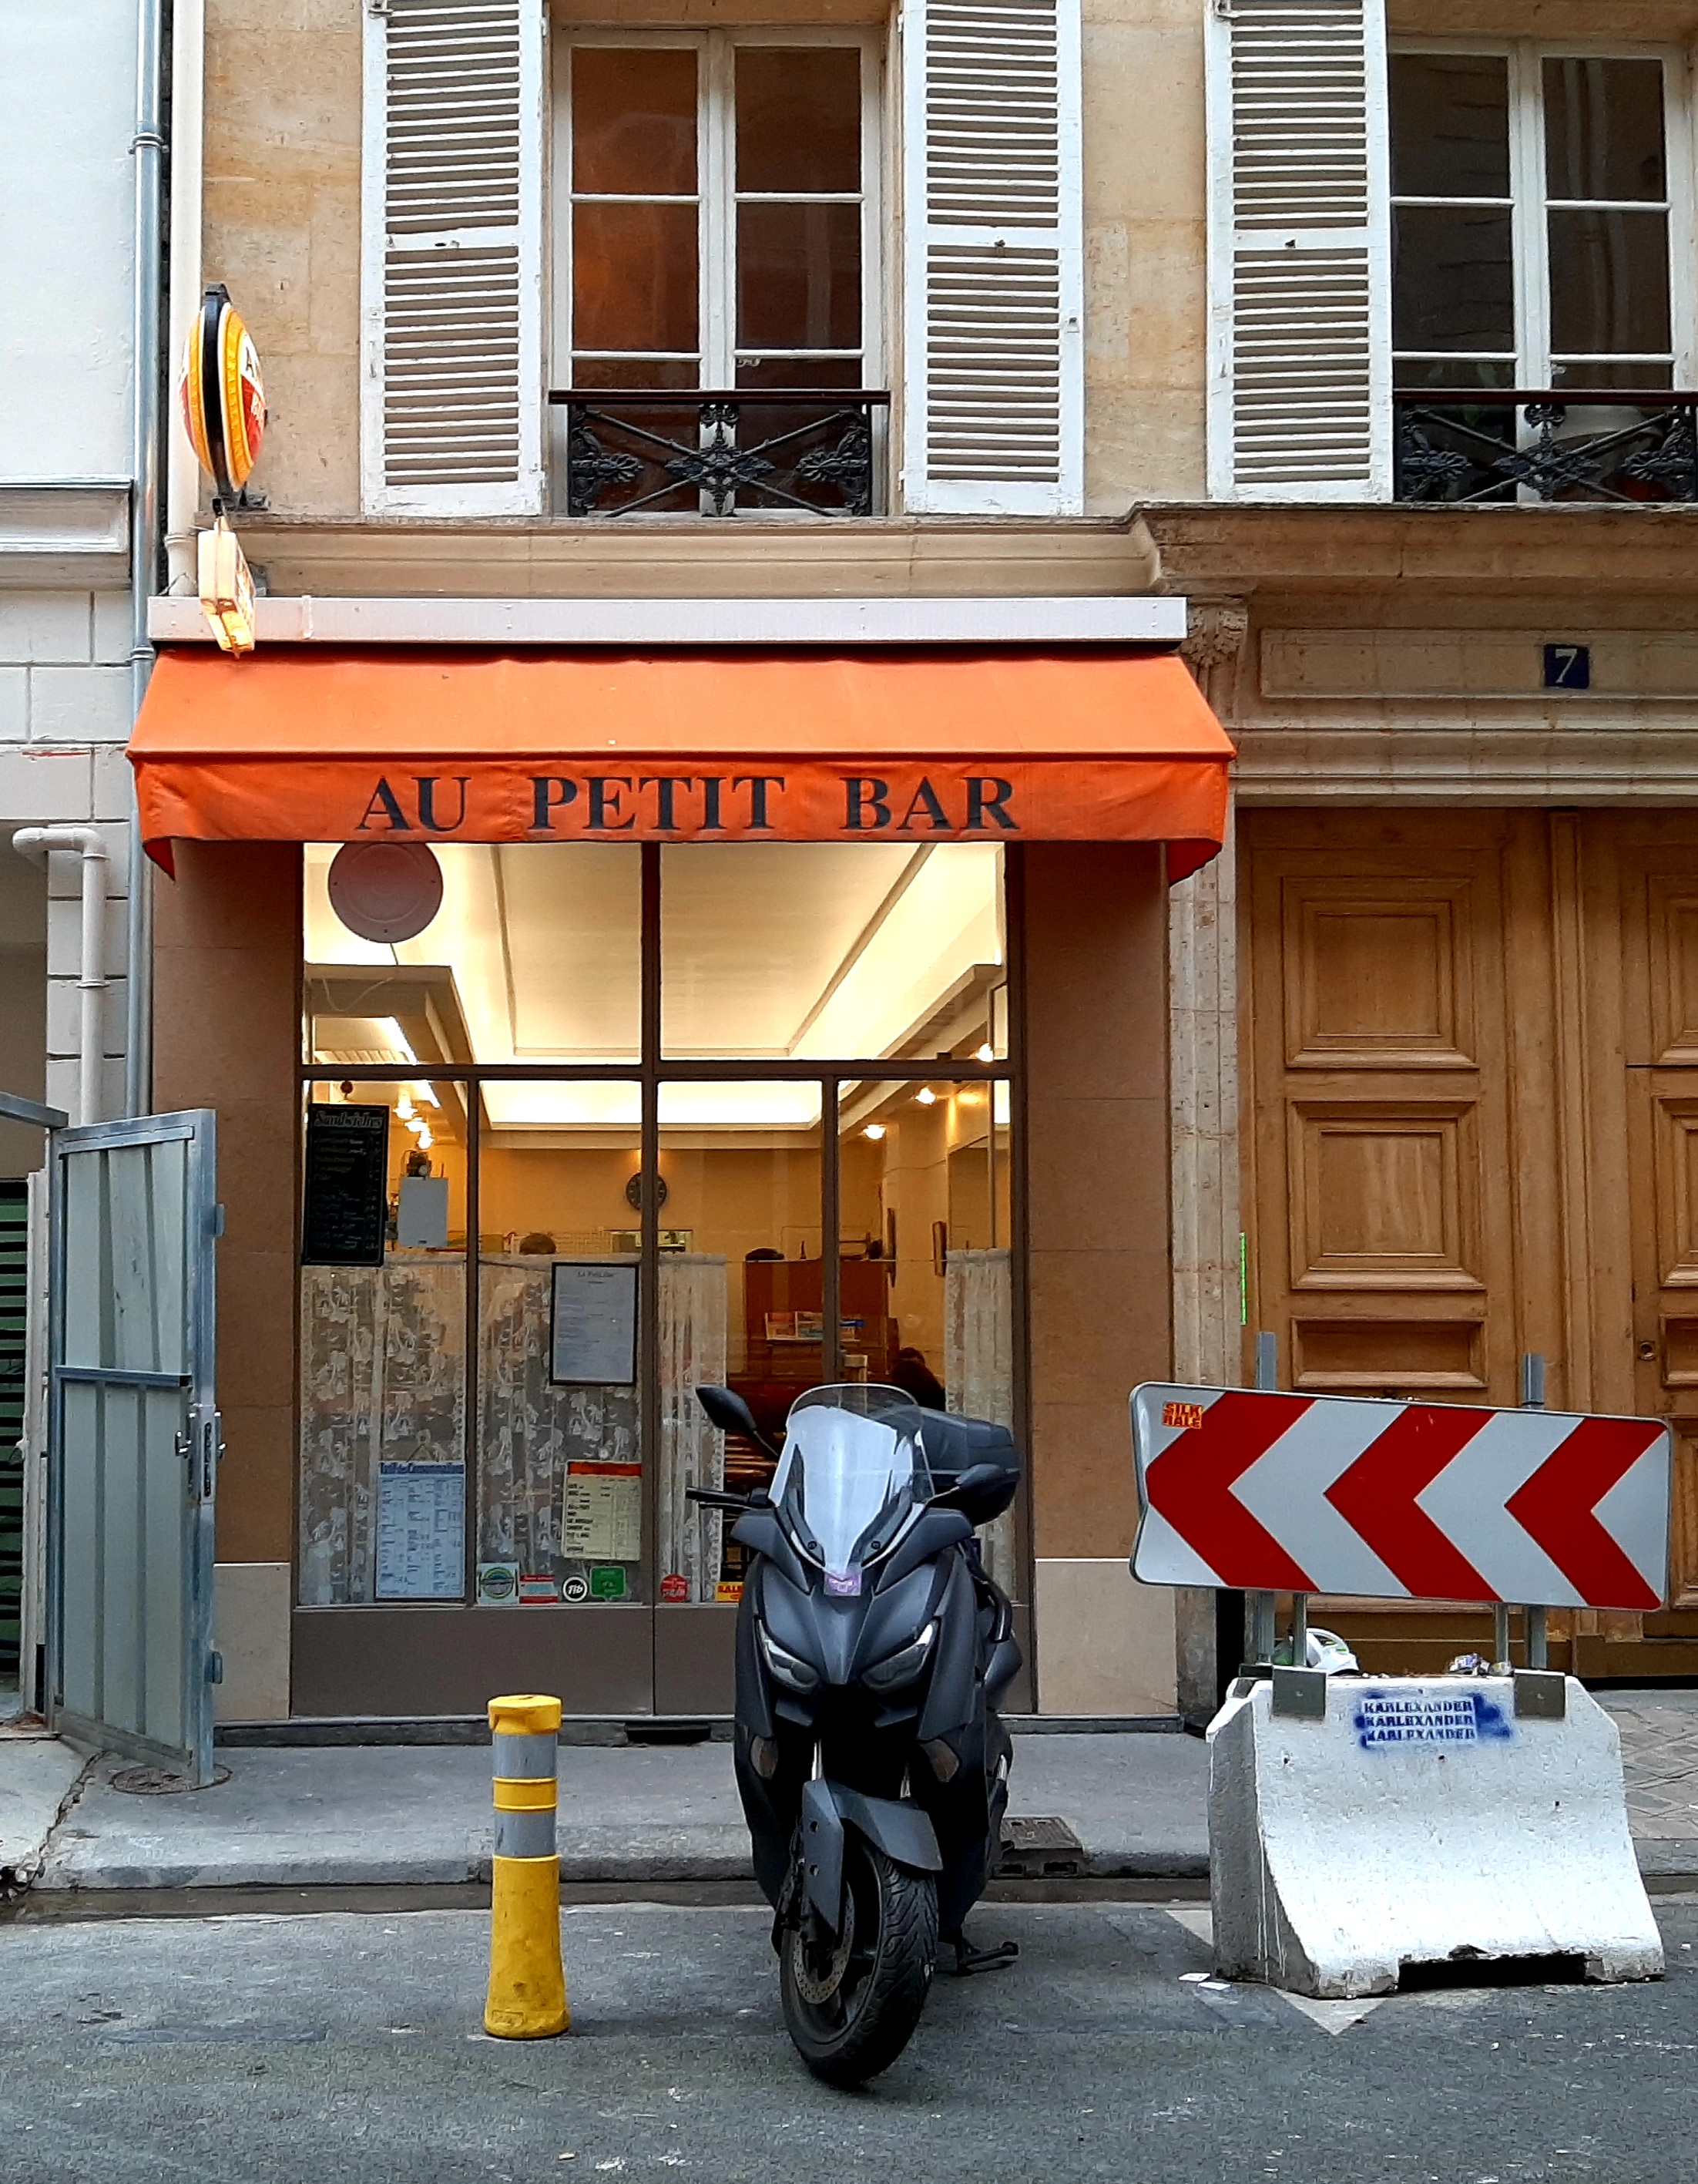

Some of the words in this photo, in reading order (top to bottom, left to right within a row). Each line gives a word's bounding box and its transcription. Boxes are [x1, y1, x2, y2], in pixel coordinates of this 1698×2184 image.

[1555, 648, 1577, 684] 7
[354, 775, 471, 832] AU
[528, 776, 785, 830] PETIT
[839, 775, 1021, 830] BAR
